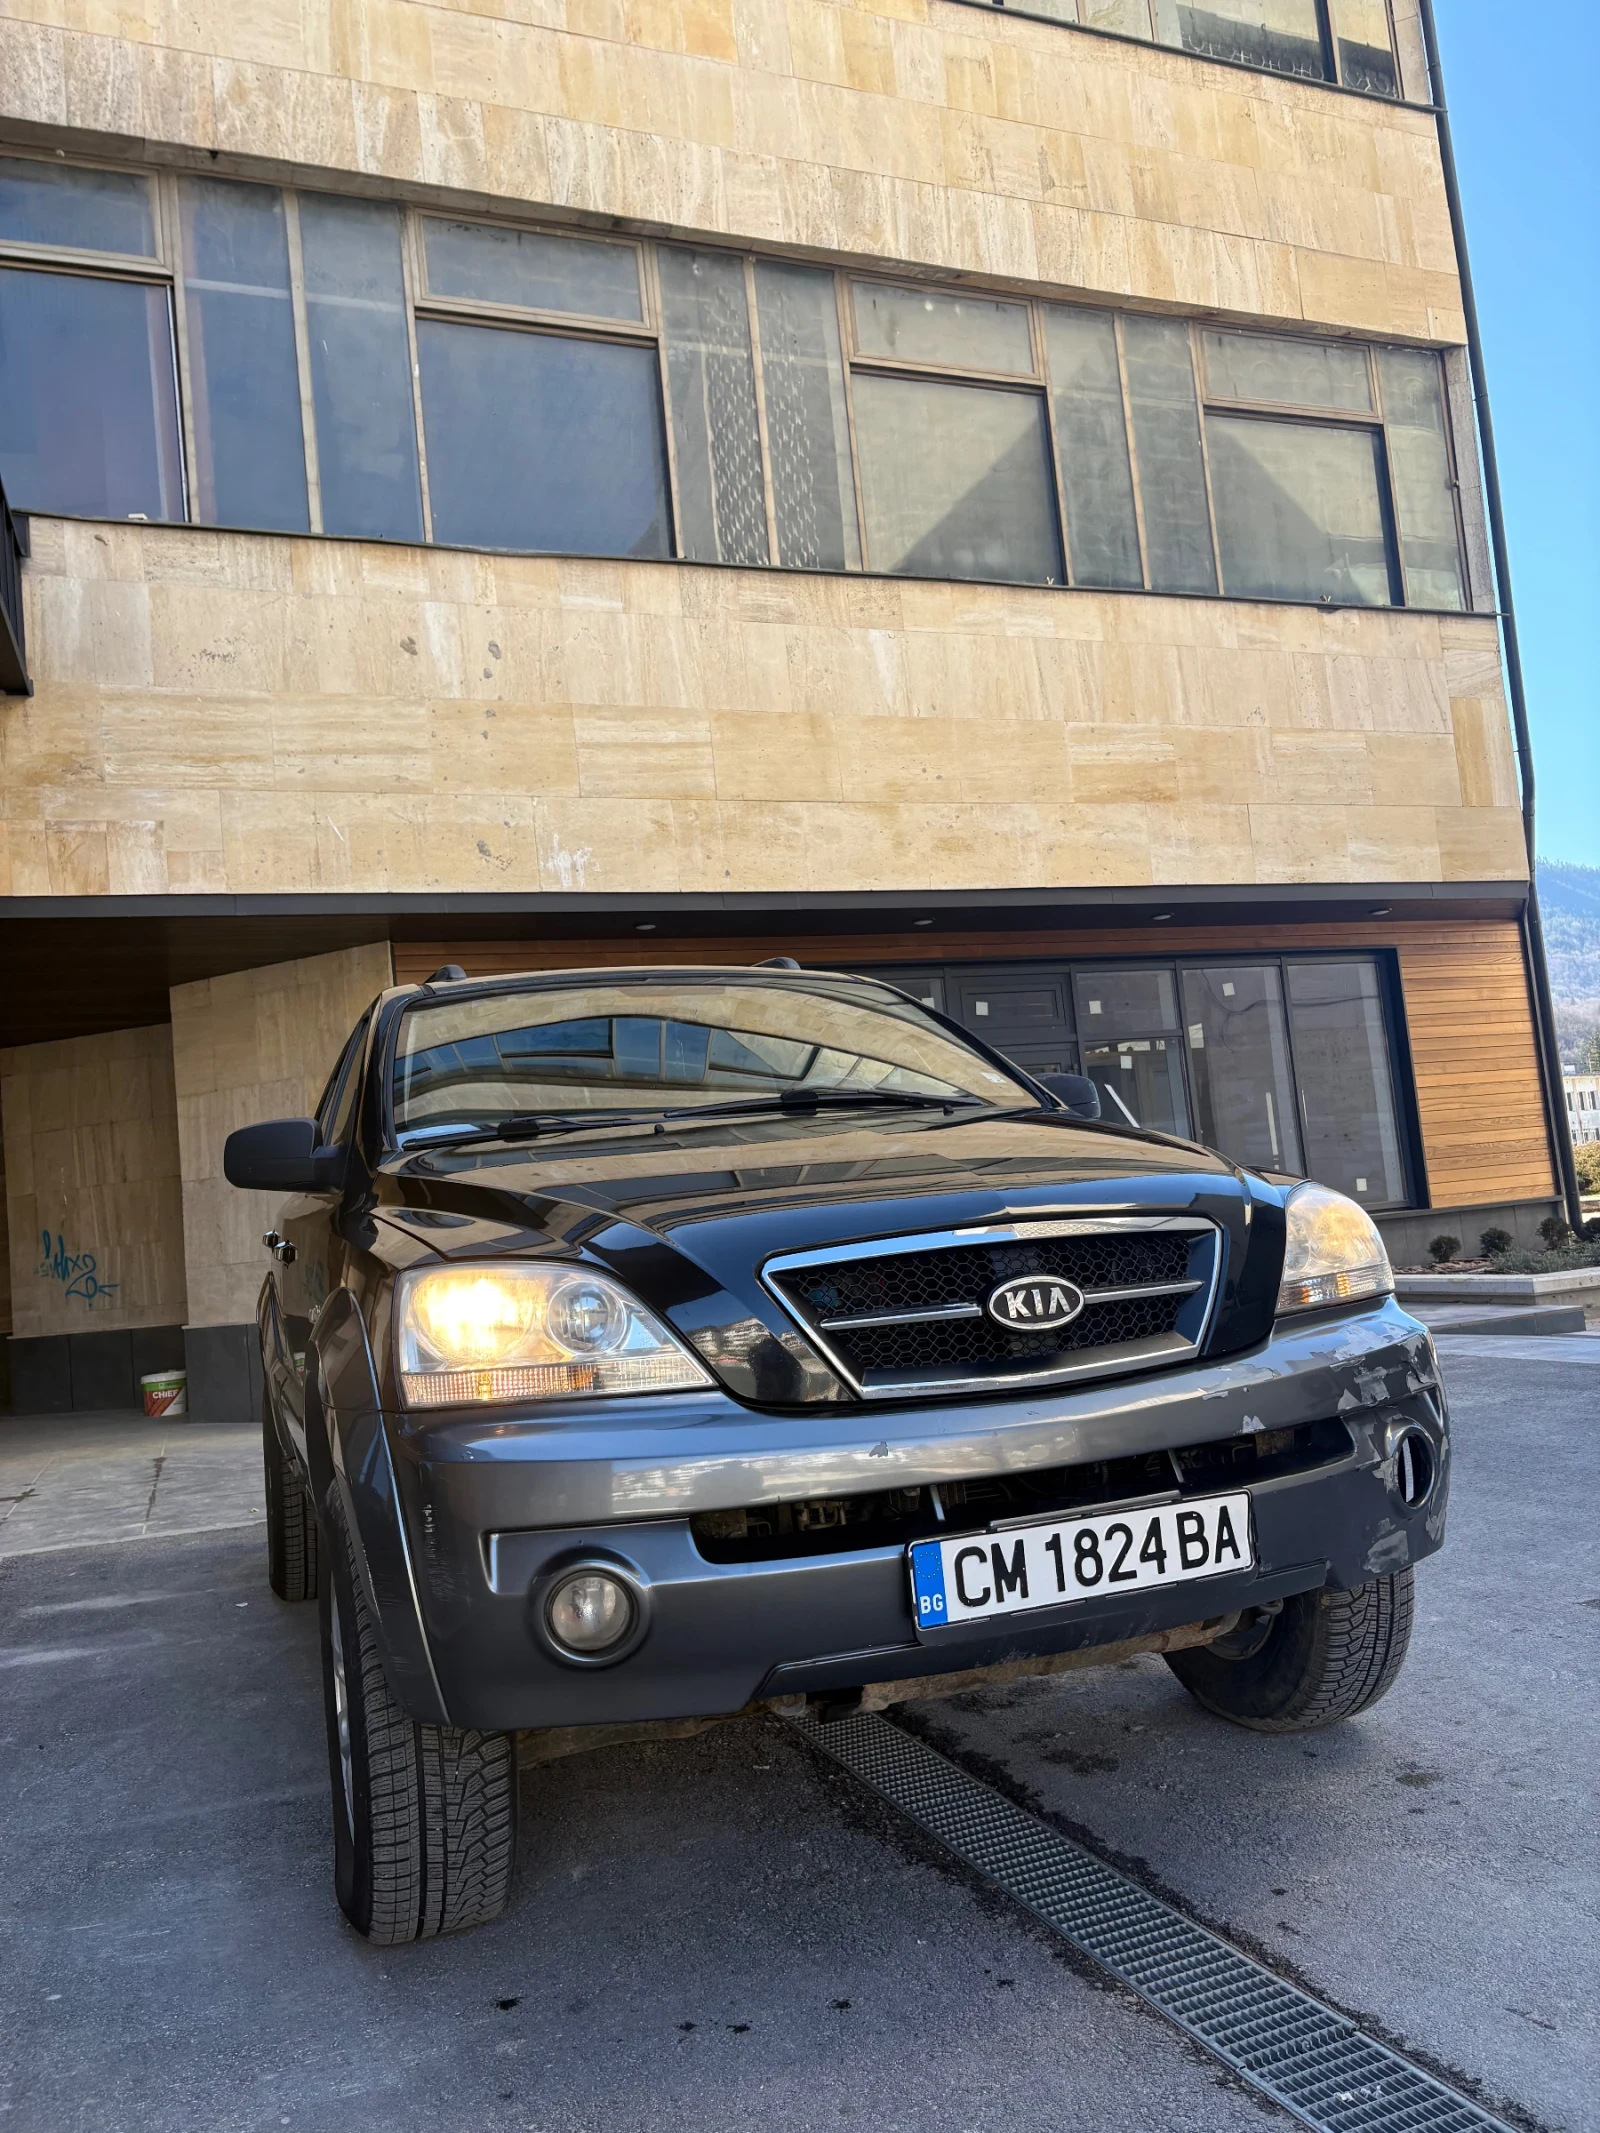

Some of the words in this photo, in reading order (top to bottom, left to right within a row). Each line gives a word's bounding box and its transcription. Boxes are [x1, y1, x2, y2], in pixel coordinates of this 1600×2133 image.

[1004, 1286, 1072, 1319] KIA
[152, 1389, 179, 1399] CHIEF
[954, 1538, 1029, 1608] CM
[1045, 1515, 1168, 1593] 1824
[1175, 1504, 1242, 1571] BA
[919, 1593, 944, 1614] BG
